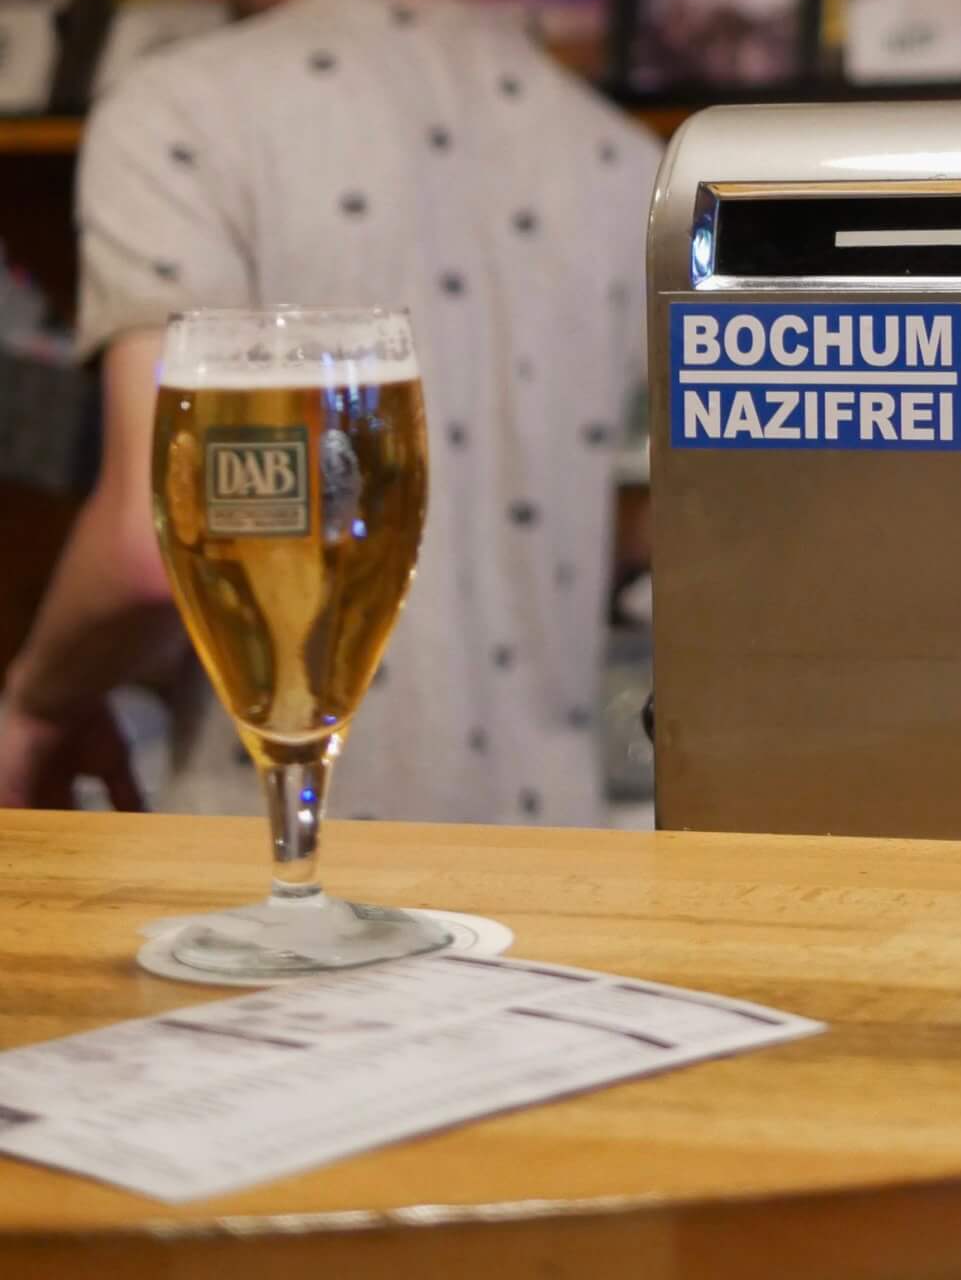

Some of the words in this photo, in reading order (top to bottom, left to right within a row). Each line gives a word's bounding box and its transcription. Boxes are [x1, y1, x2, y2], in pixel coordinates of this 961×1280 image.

[683, 314, 953, 367] BOCHUM
[684, 390, 953, 441] NAZIFREI
[218, 450, 297, 496] DAB
